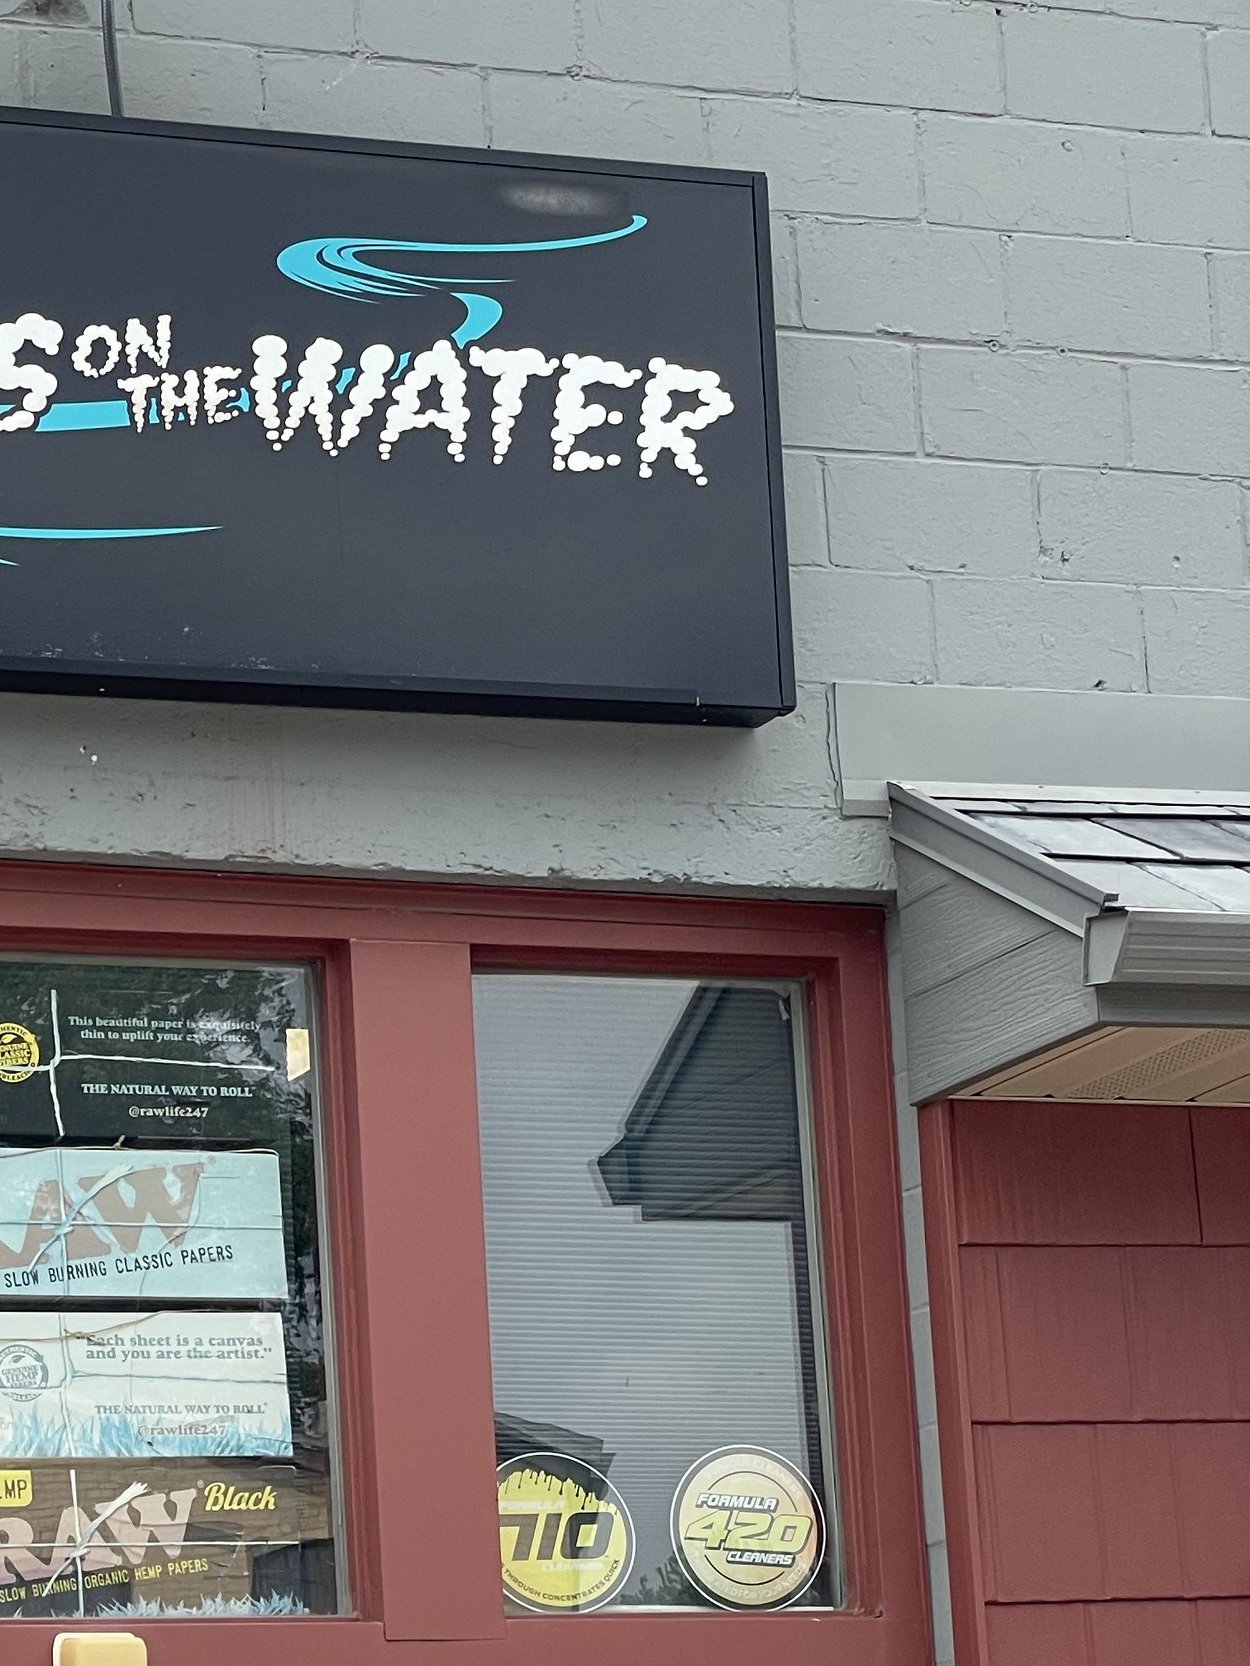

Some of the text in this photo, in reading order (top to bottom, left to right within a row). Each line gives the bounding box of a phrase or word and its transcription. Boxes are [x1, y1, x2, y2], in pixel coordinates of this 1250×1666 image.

[70, 314, 173, 379] ON
[117, 364, 243, 432] THE
[249, 335, 735, 486] WATER
[68, 1016, 93, 1027] This
[96, 1016, 148, 1028] beautiful
[151, 1019, 182, 1031] paper
[186, 1019, 196, 1029] is
[81, 1029, 105, 1040] thin
[107, 1030, 120, 1040] to
[122, 1030, 155, 1043] uplift
[156, 1033, 183, 1044] your
[81, 1083, 253, 1098] THE NATURAL WAY TO ROLL
[128, 1105, 209, 1119] @rawlife247
[4, 1244, 234, 1289] SLOW BURNING CLASSIC PAPERS
[129, 1334, 171, 1347] sheet
[176, 1335, 189, 1347] is
[194, 1336, 205, 1347] a
[208, 1336, 263, 1347] canvas
[86, 1349, 116, 1360] and
[122, 1350, 150, 1362] you
[156, 1350, 182, 1360] are
[187, 1348, 213, 1360] the
[94, 1404, 120, 1415] THE
[124, 1404, 182, 1415] NATURAL
[184, 1405, 211, 1415] WAY
[214, 1404, 230, 1415] TO
[203, 1481, 278, 1512] Black
[697, 1493, 778, 1511] FORMULA
[499, 1511, 615, 1562] 710
[684, 1509, 814, 1555] 420
[726, 1552, 794, 1566] CLEANERS
[84, 1569, 130, 1590] ORGANIC
[134, 1564, 163, 1581] HEMP
[168, 1558, 209, 1576] PAPERS
[504, 1559, 620, 1602] THROUGH CONCENTRATES QUICK
